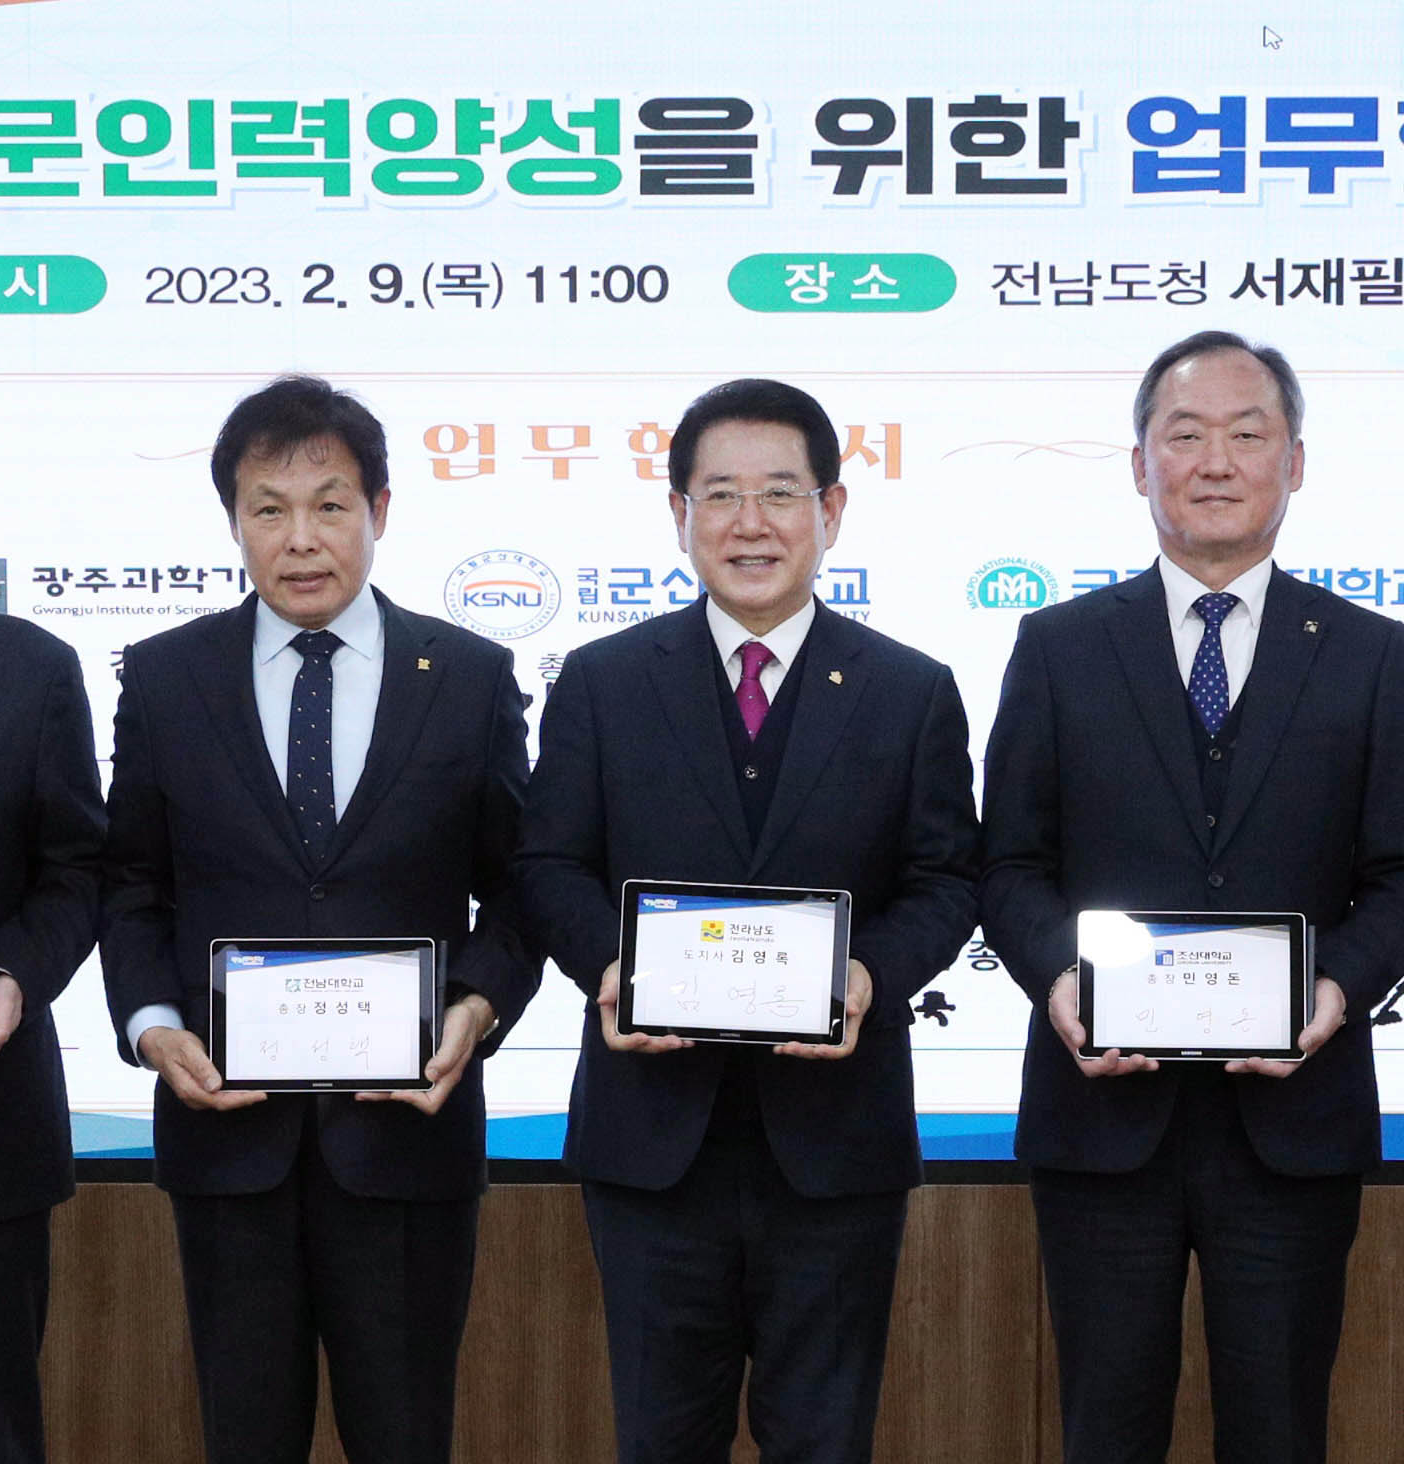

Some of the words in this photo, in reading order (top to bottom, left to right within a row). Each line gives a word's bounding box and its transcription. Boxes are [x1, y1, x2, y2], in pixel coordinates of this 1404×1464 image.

[812, 95, 1079, 195] 위한
[145, 267, 282, 308] 2023.
[525, 265, 670, 304] 11:00
[991, 260, 1208, 307] 전남도청
[32, 565, 247, 598] 광주과학기
[32, 604, 93, 617] Gwangju
[96, 604, 155, 615] Institute
[157, 604, 172, 615] of
[463, 591, 542, 608] KSNU
[729, 923, 775, 936] 전라남도
